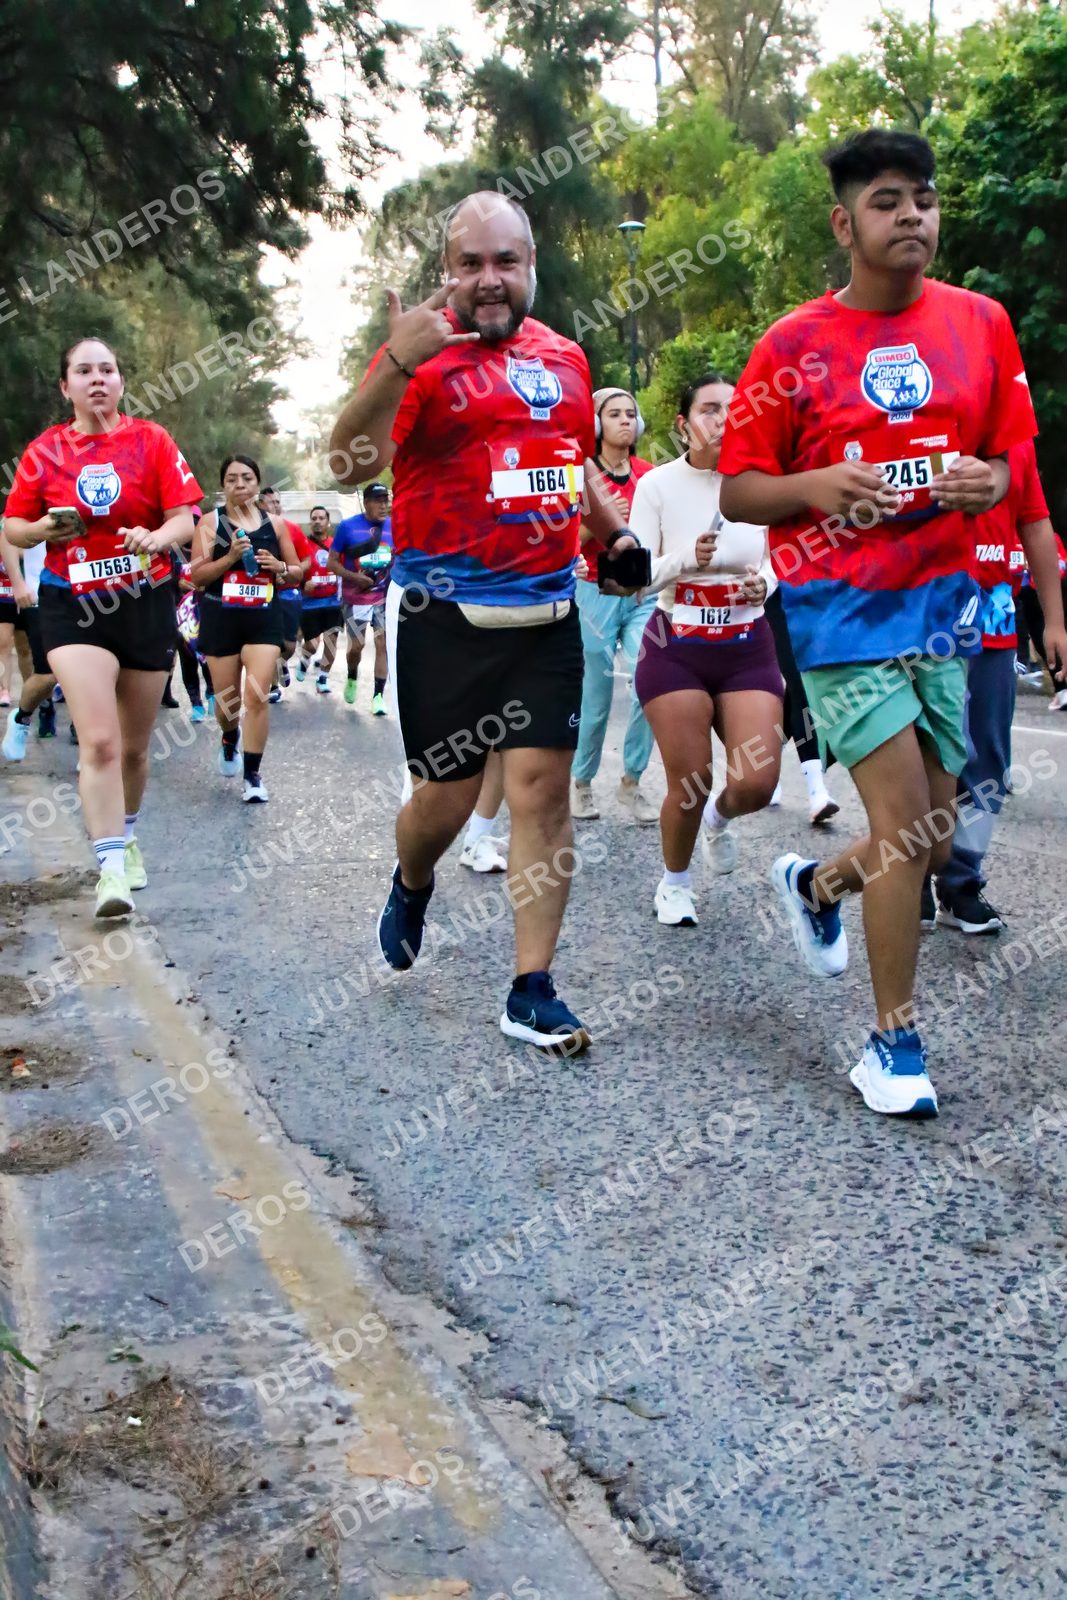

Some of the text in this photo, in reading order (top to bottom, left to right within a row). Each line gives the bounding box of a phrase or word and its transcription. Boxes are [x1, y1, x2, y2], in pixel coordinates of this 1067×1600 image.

[874, 352, 911, 363] BIMBO
[877, 364, 913, 380] Global
[873, 378, 902, 390] Race
[528, 468, 566, 493] 1664
[877, 459, 928, 488] 245
[89, 556, 132, 579] 17563
[239, 585, 260, 596] 3481
[700, 607, 731, 625] 1612
